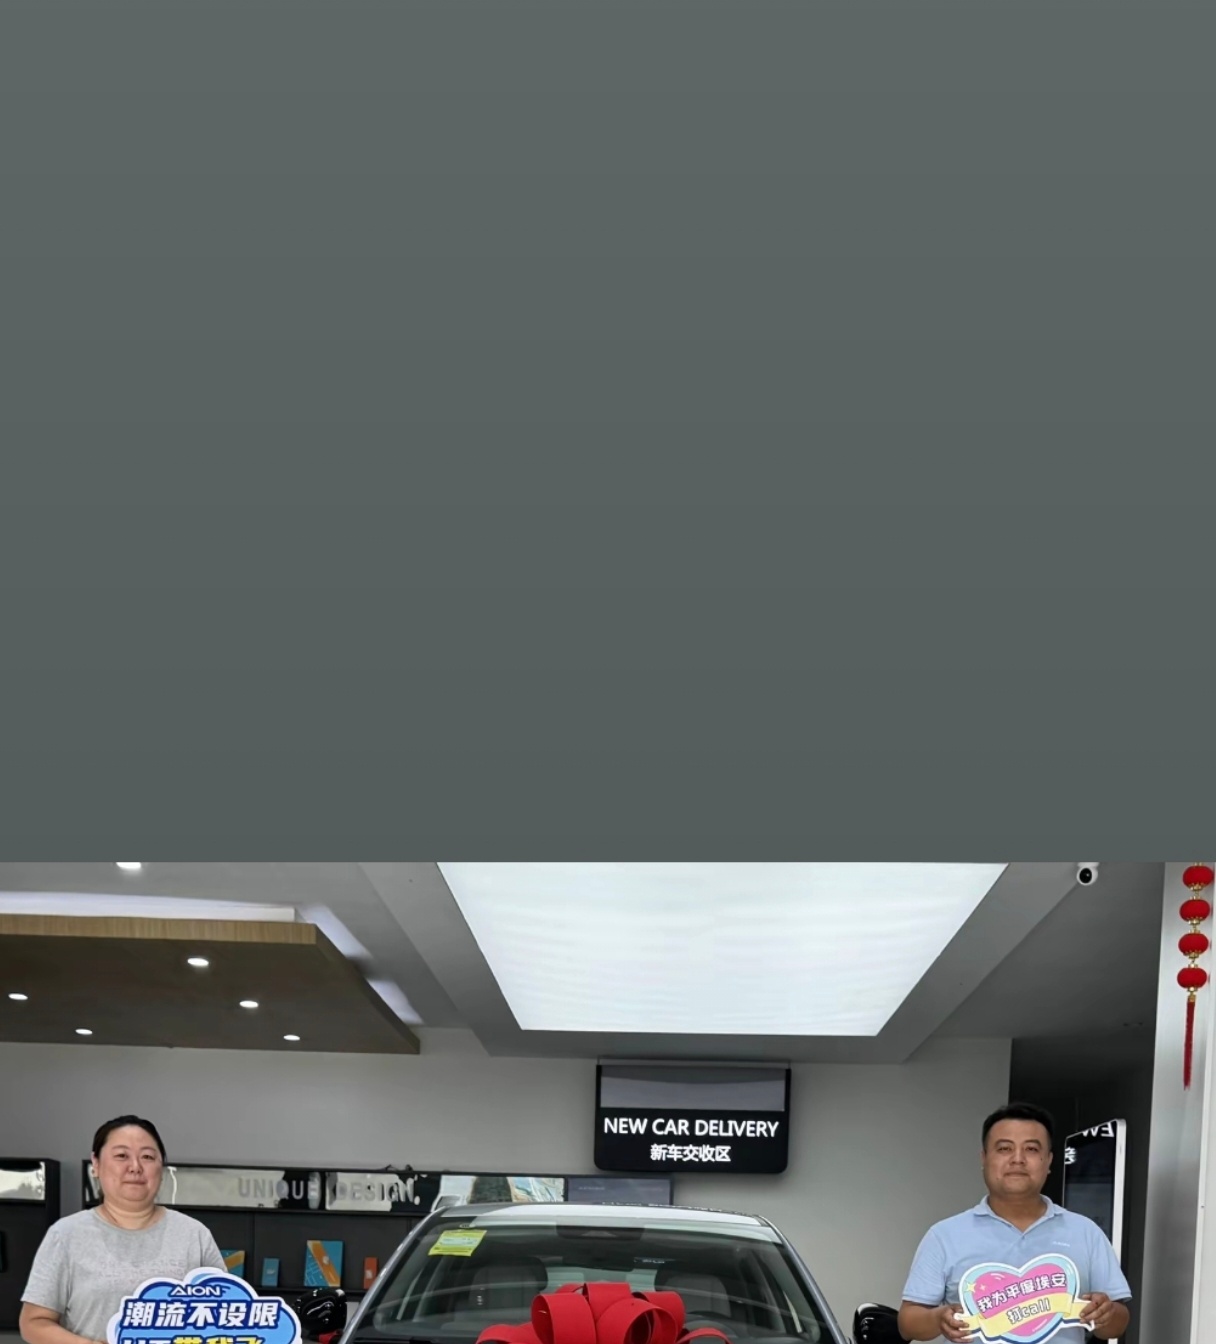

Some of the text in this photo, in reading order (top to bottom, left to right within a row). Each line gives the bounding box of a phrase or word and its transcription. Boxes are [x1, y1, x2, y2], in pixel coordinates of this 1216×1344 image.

[604, 1117, 779, 1137] NEW CAR DELIVERY
[650, 1144, 732, 1162] 新车交收区
[238, 1178, 320, 1200] UNIQUE
[170, 1285, 221, 1296] AION
[977, 1273, 1067, 1313] 我为平度埃安
[123, 1302, 279, 1327] 潮流不设限
[1006, 1297, 1051, 1324] 打call
